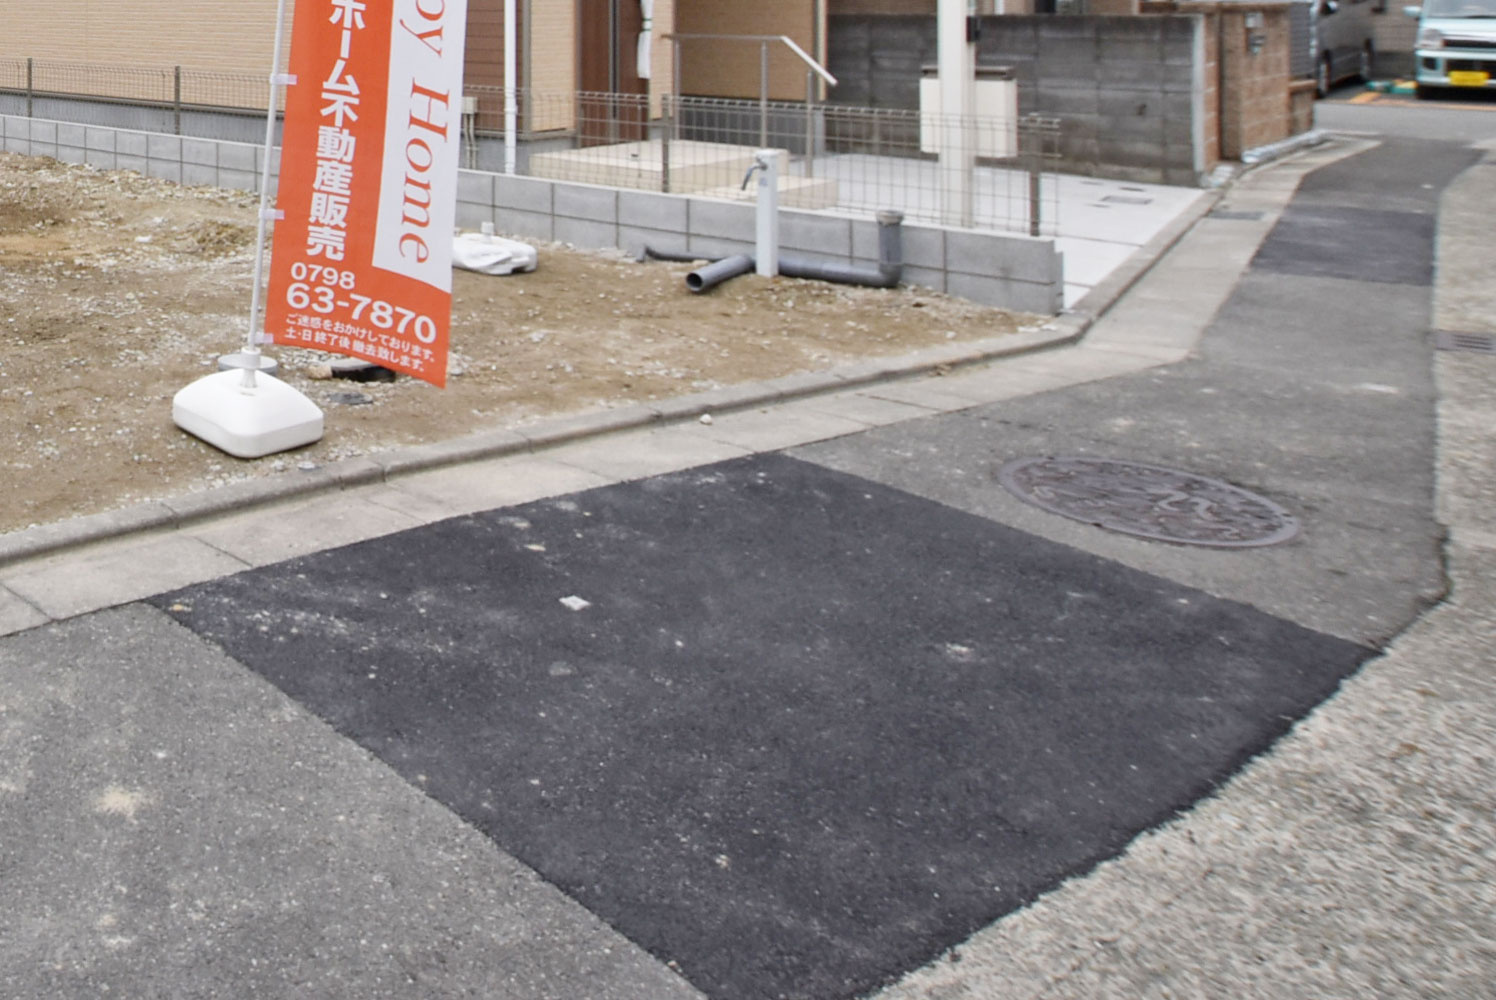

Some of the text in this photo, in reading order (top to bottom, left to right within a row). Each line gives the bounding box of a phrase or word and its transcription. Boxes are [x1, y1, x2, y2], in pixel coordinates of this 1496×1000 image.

[398, 77, 450, 264] Home
[291, 262, 355, 290] 0798
[286, 282, 437, 344] 63-7870
